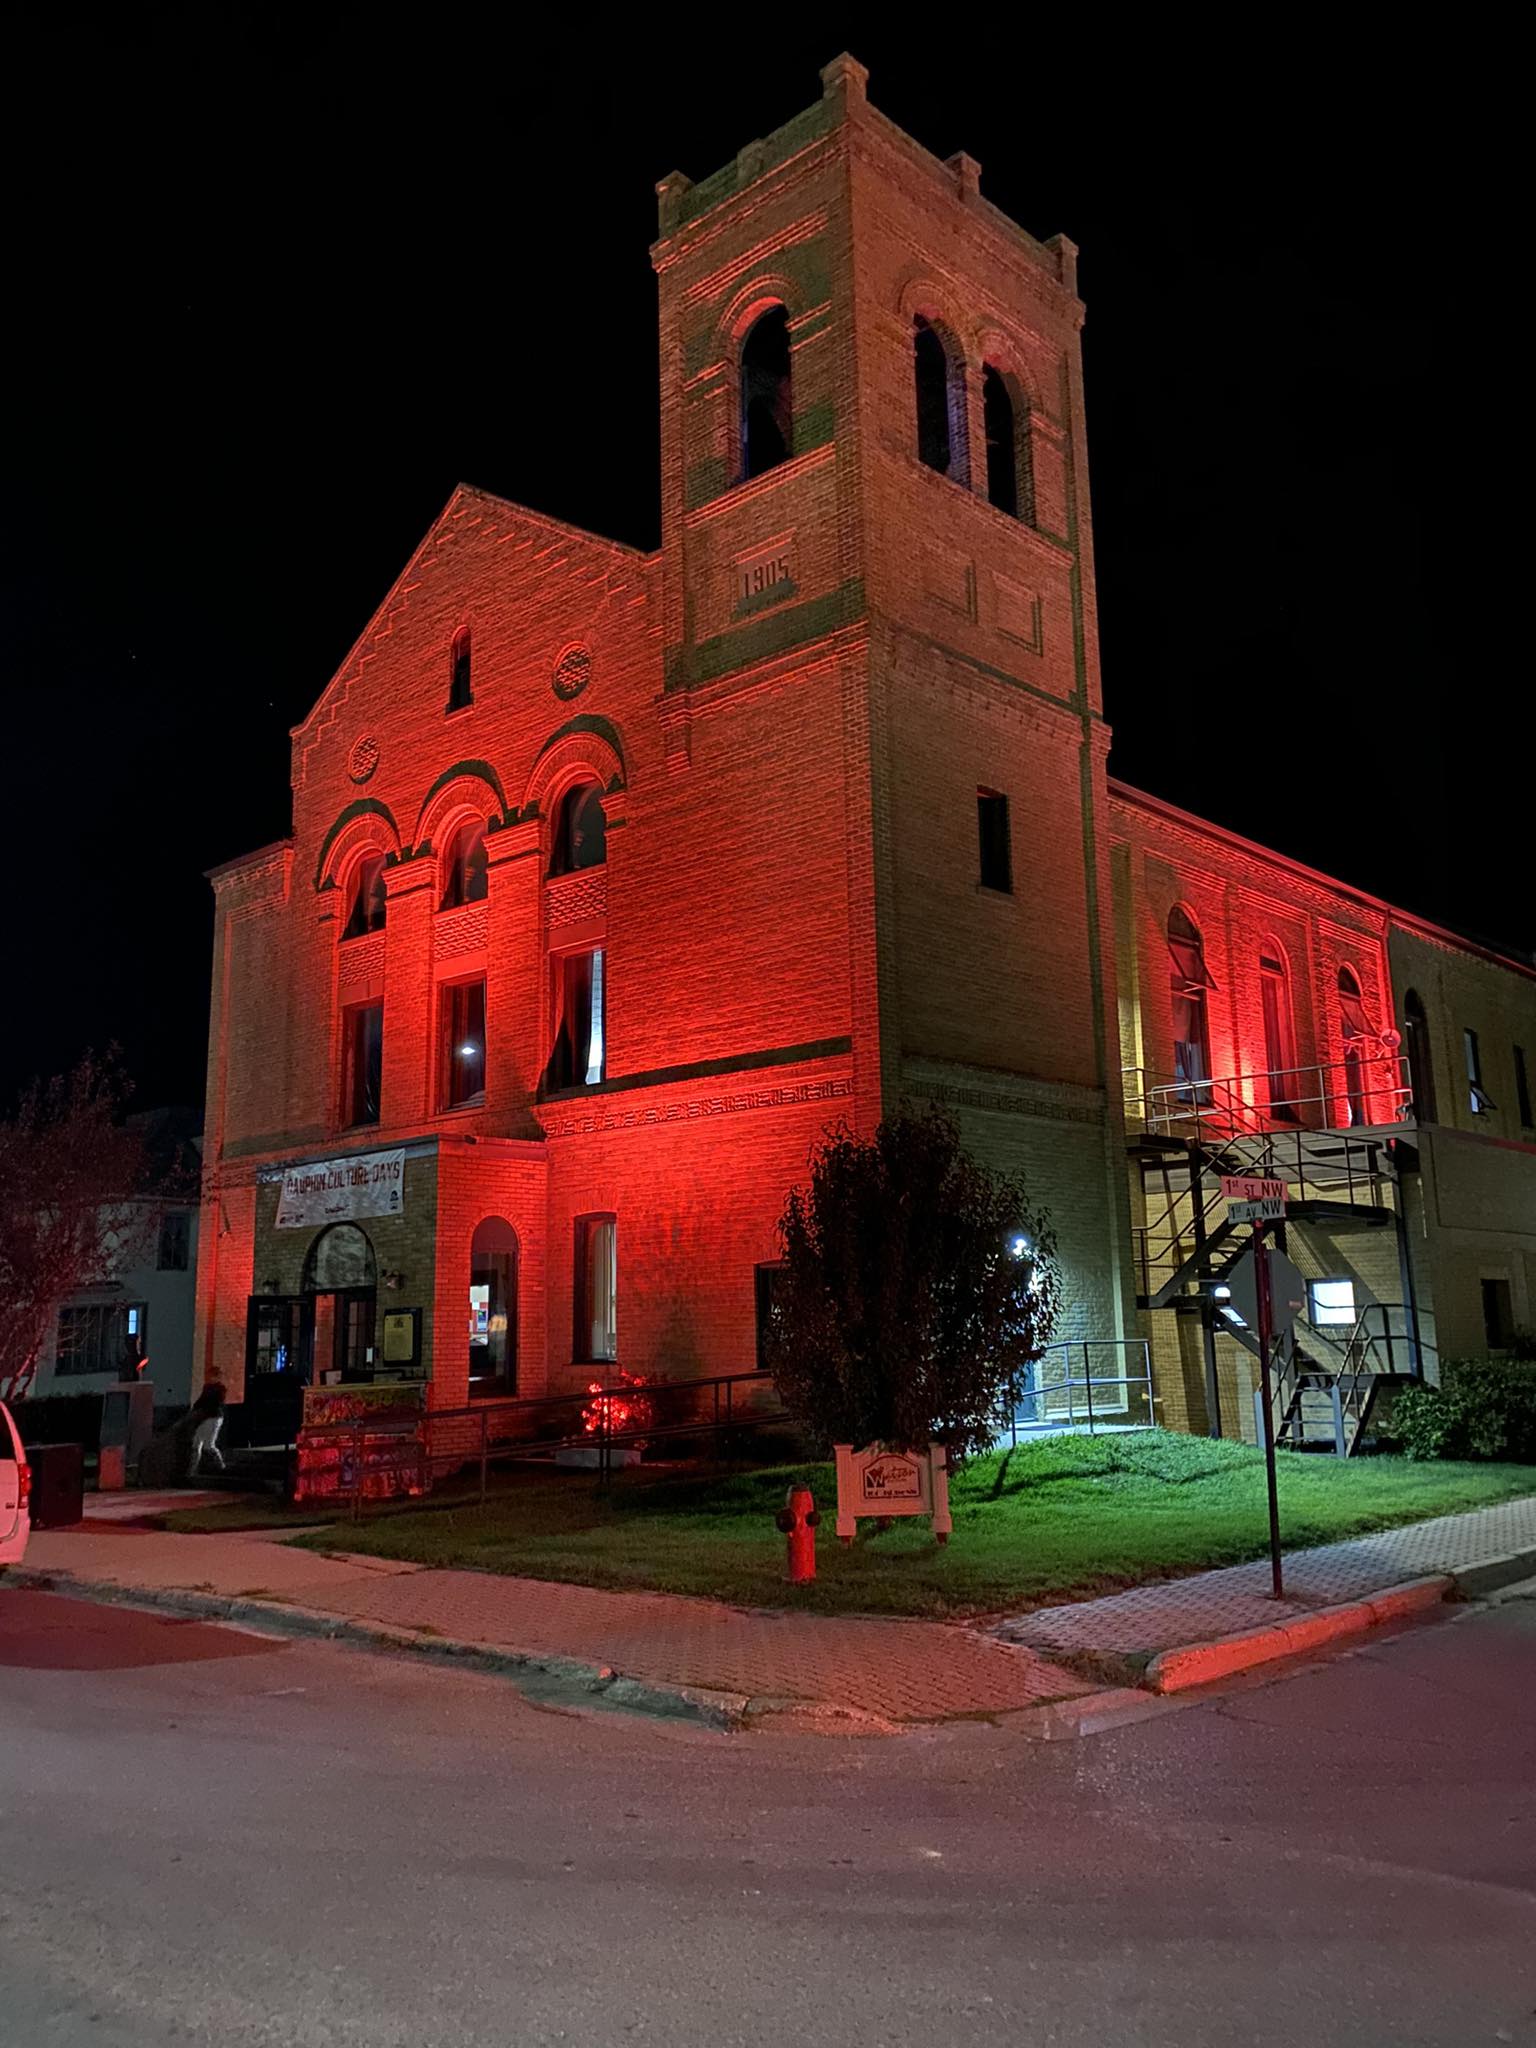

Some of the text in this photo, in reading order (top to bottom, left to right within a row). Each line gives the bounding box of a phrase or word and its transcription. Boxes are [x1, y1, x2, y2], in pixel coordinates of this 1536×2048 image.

[745, 554, 789, 599] 1905
[286, 1161, 400, 1194] DAUPHIN CULTURE DAYS
[1226, 1180, 1283, 1197] 1st ST NW
[1246, 1207, 1257, 1217] AV
[1262, 1200, 1280, 1215] NW
